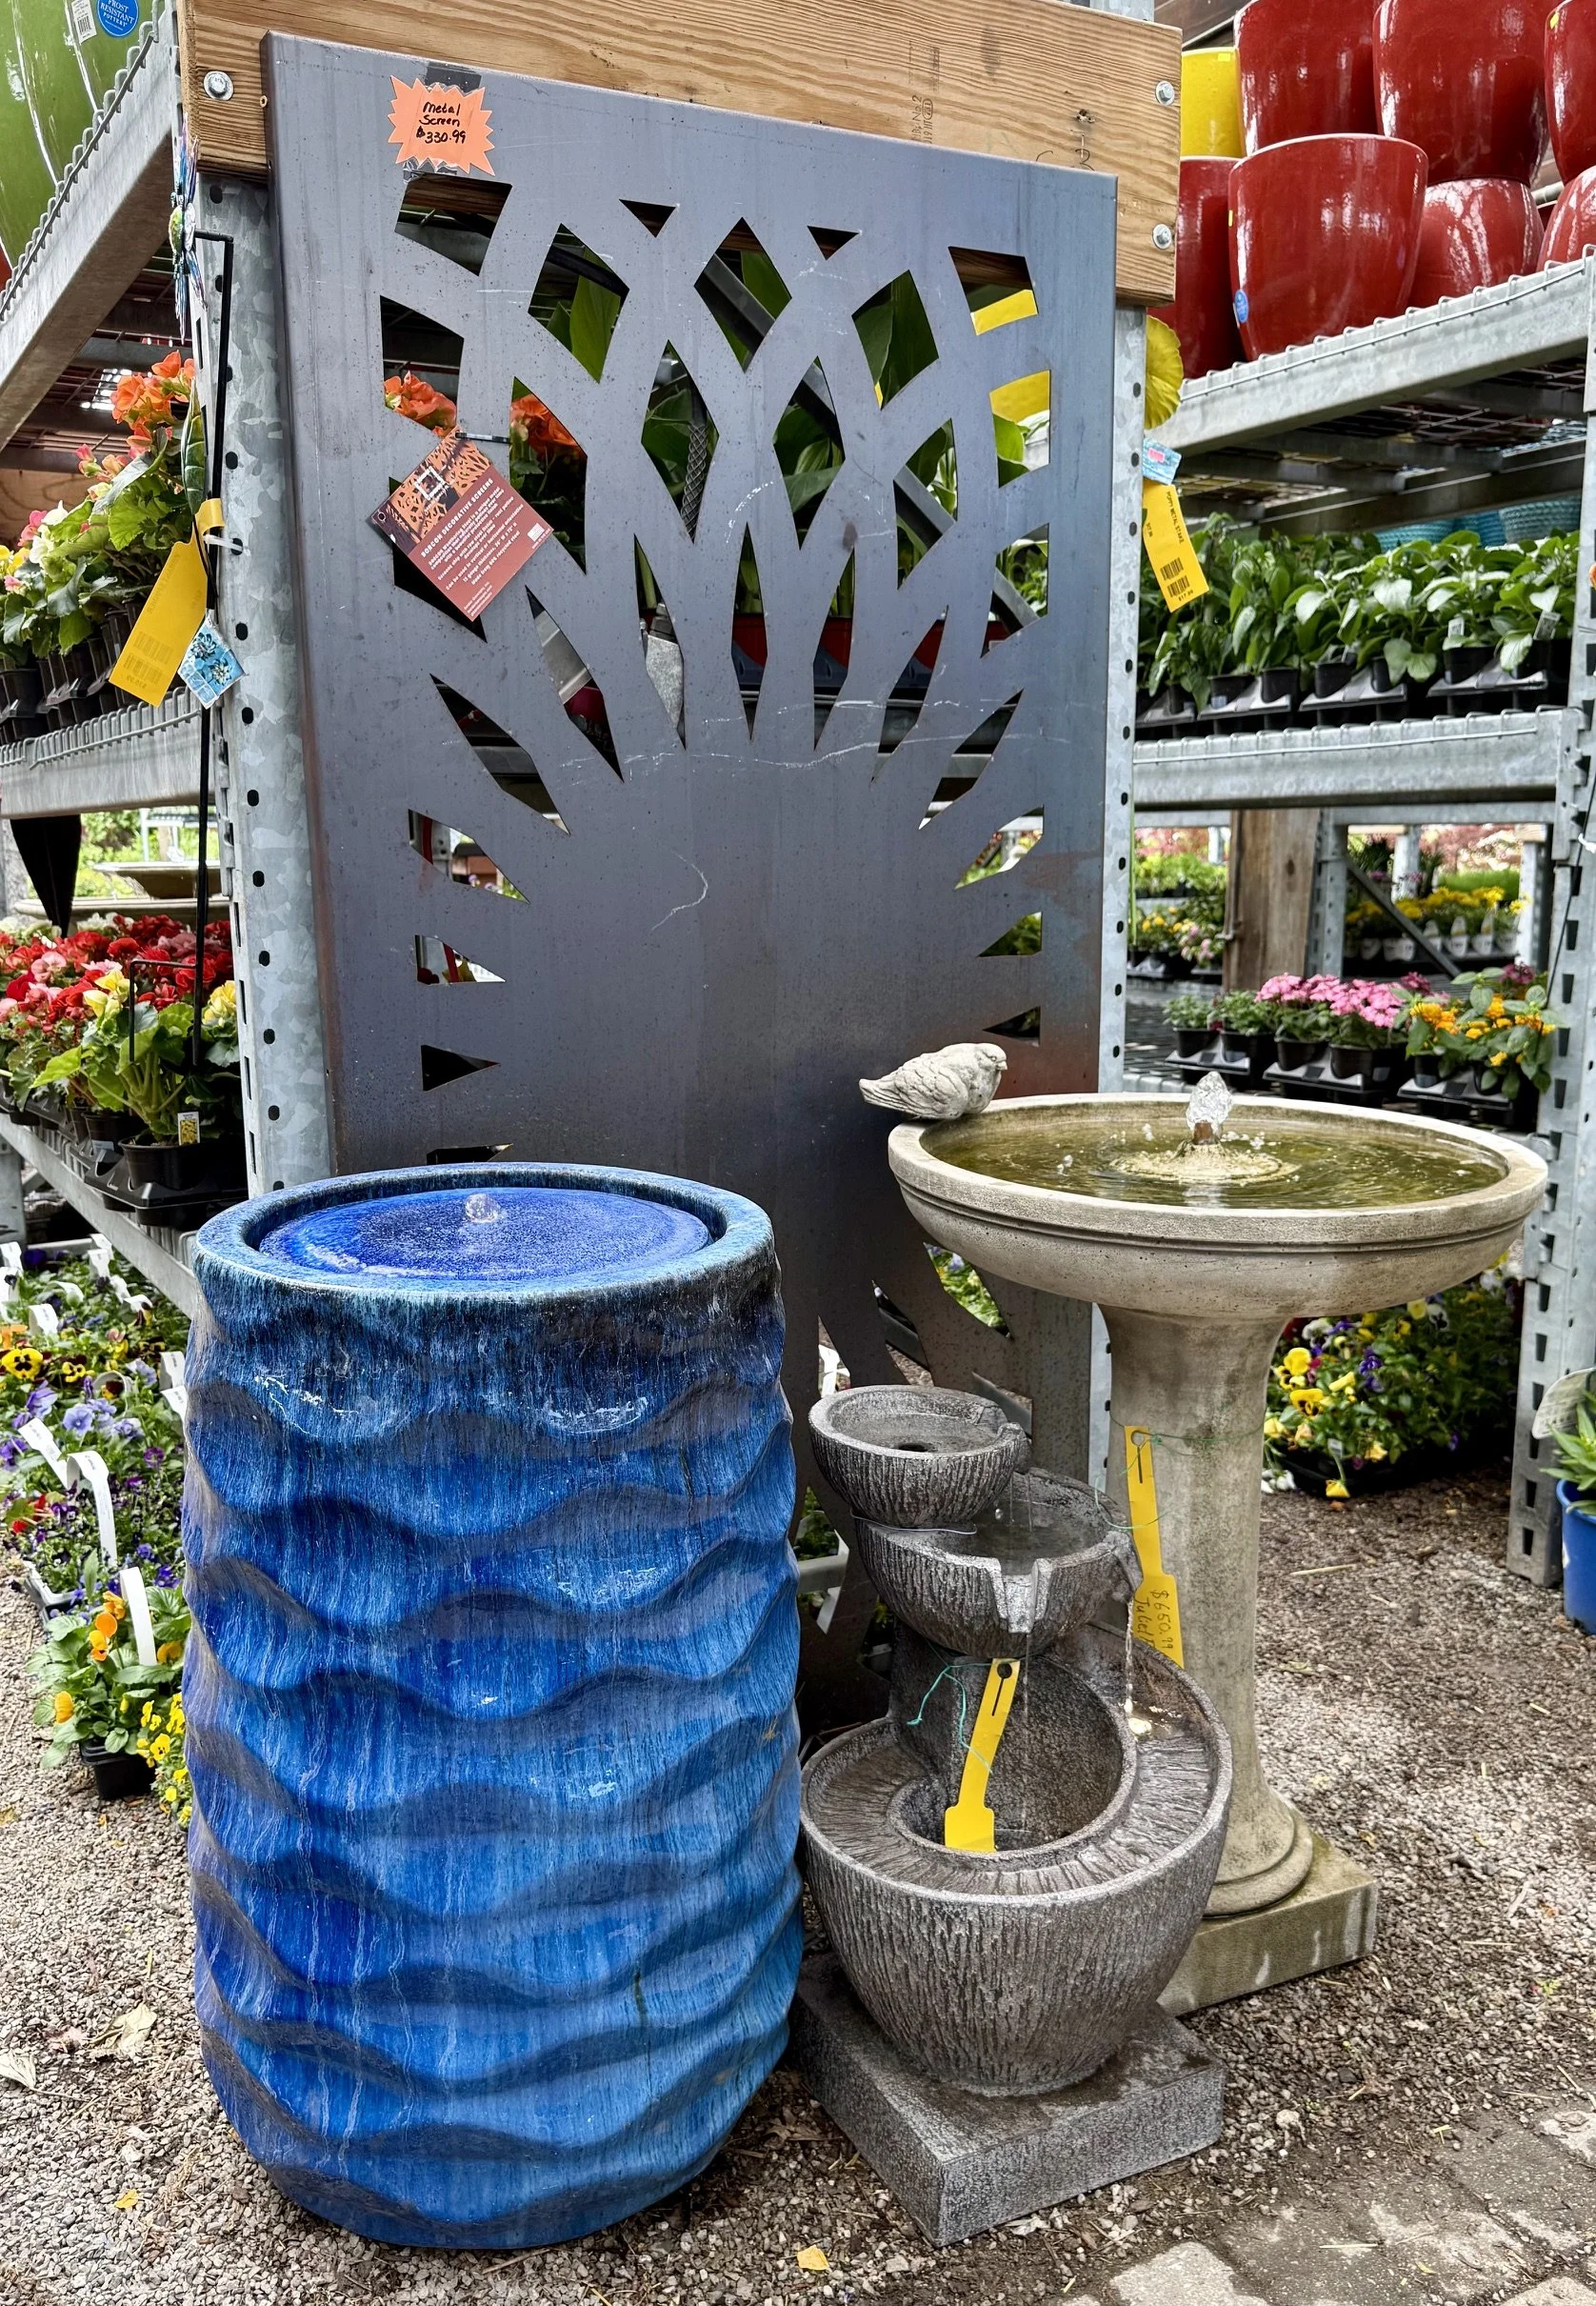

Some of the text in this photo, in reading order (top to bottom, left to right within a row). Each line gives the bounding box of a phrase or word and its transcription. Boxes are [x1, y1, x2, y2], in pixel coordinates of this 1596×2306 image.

[101, 3, 134, 24] RESISTANT
[109, 0, 129, 12] FROST
[103, 12, 127, 27] POTTERY
[422, 101, 461, 116] Metal
[419, 114, 461, 128] Screen
[415, 125, 467, 144] $330.99
[440, 500, 473, 535] DECORATIVE
[469, 477, 494, 503] SCREENS
[1150, 1590, 1174, 1649] $650.99
